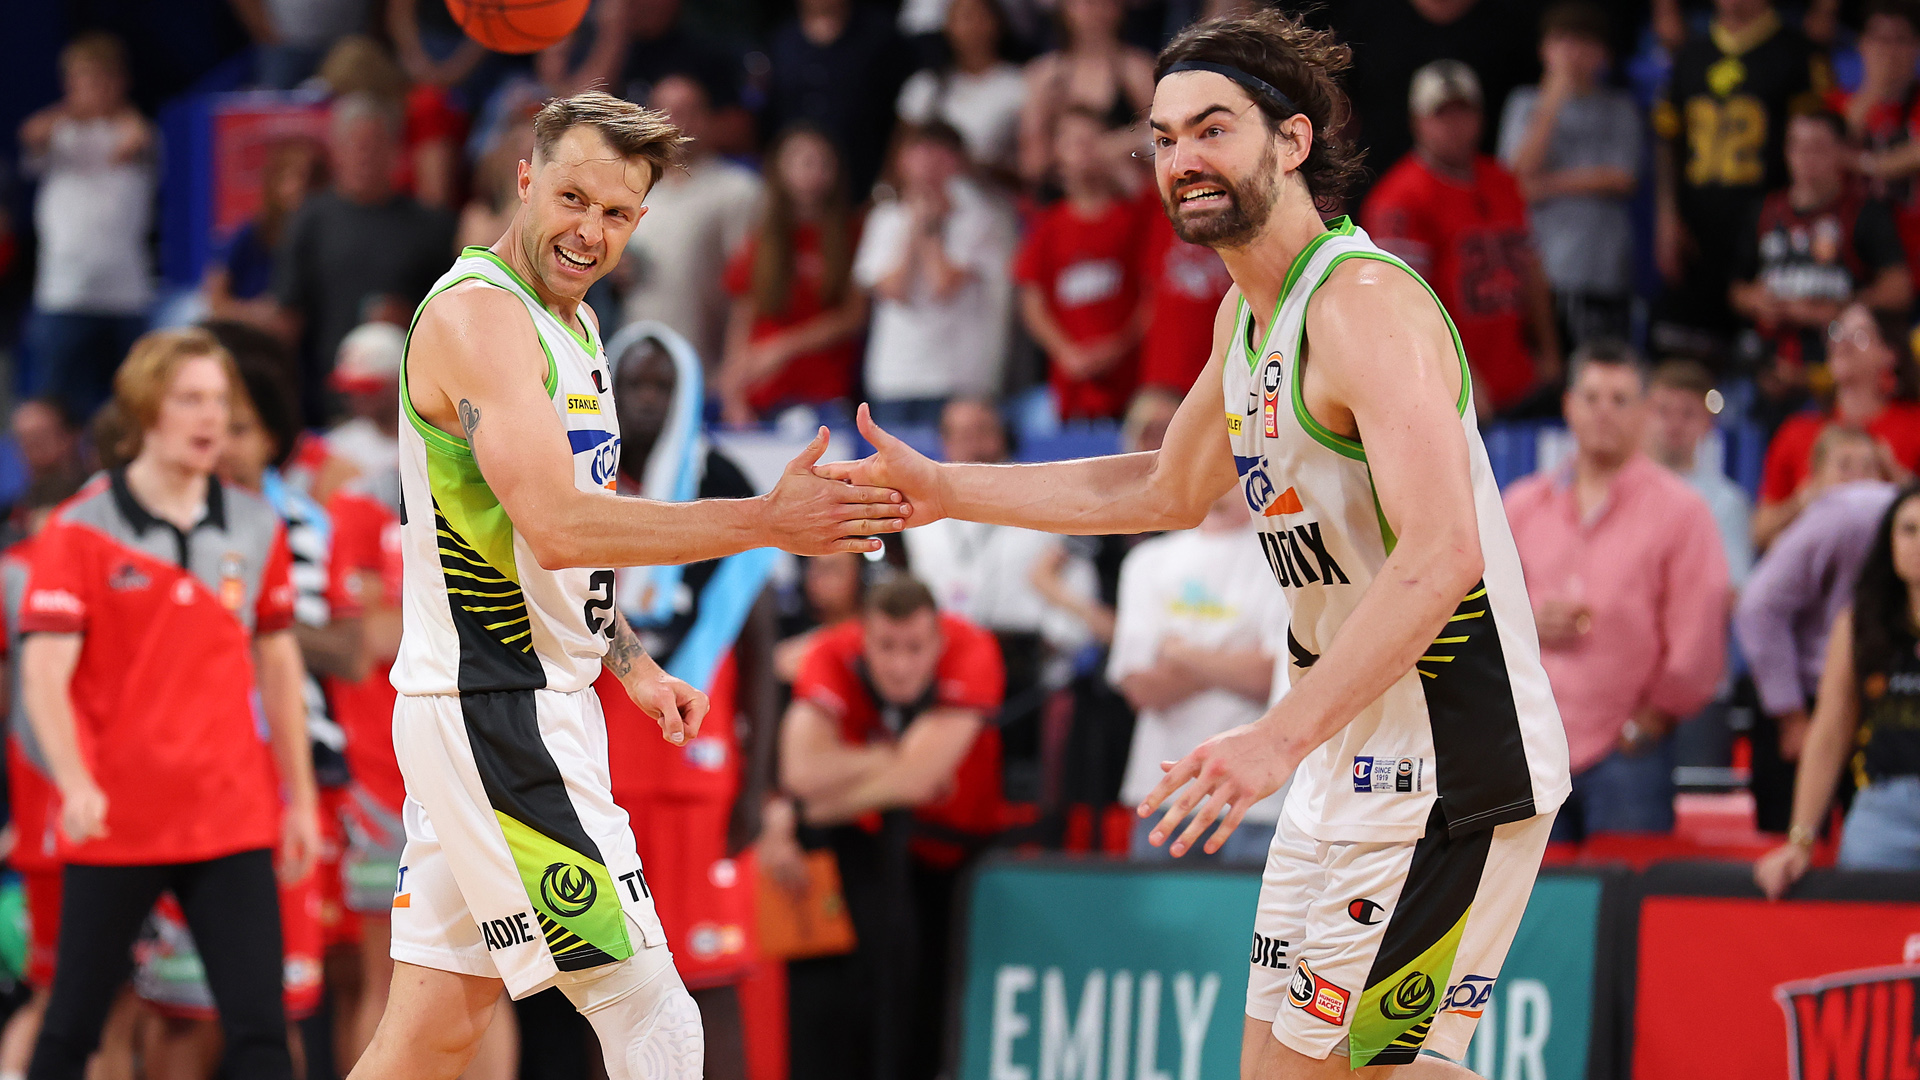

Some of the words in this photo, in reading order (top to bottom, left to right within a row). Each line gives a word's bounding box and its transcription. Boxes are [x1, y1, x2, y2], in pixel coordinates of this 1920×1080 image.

[1374, 766, 1392, 774] SINCE
[1319, 993, 1342, 1006] HUNGRY
[989, 963, 1221, 1080] EMILY
